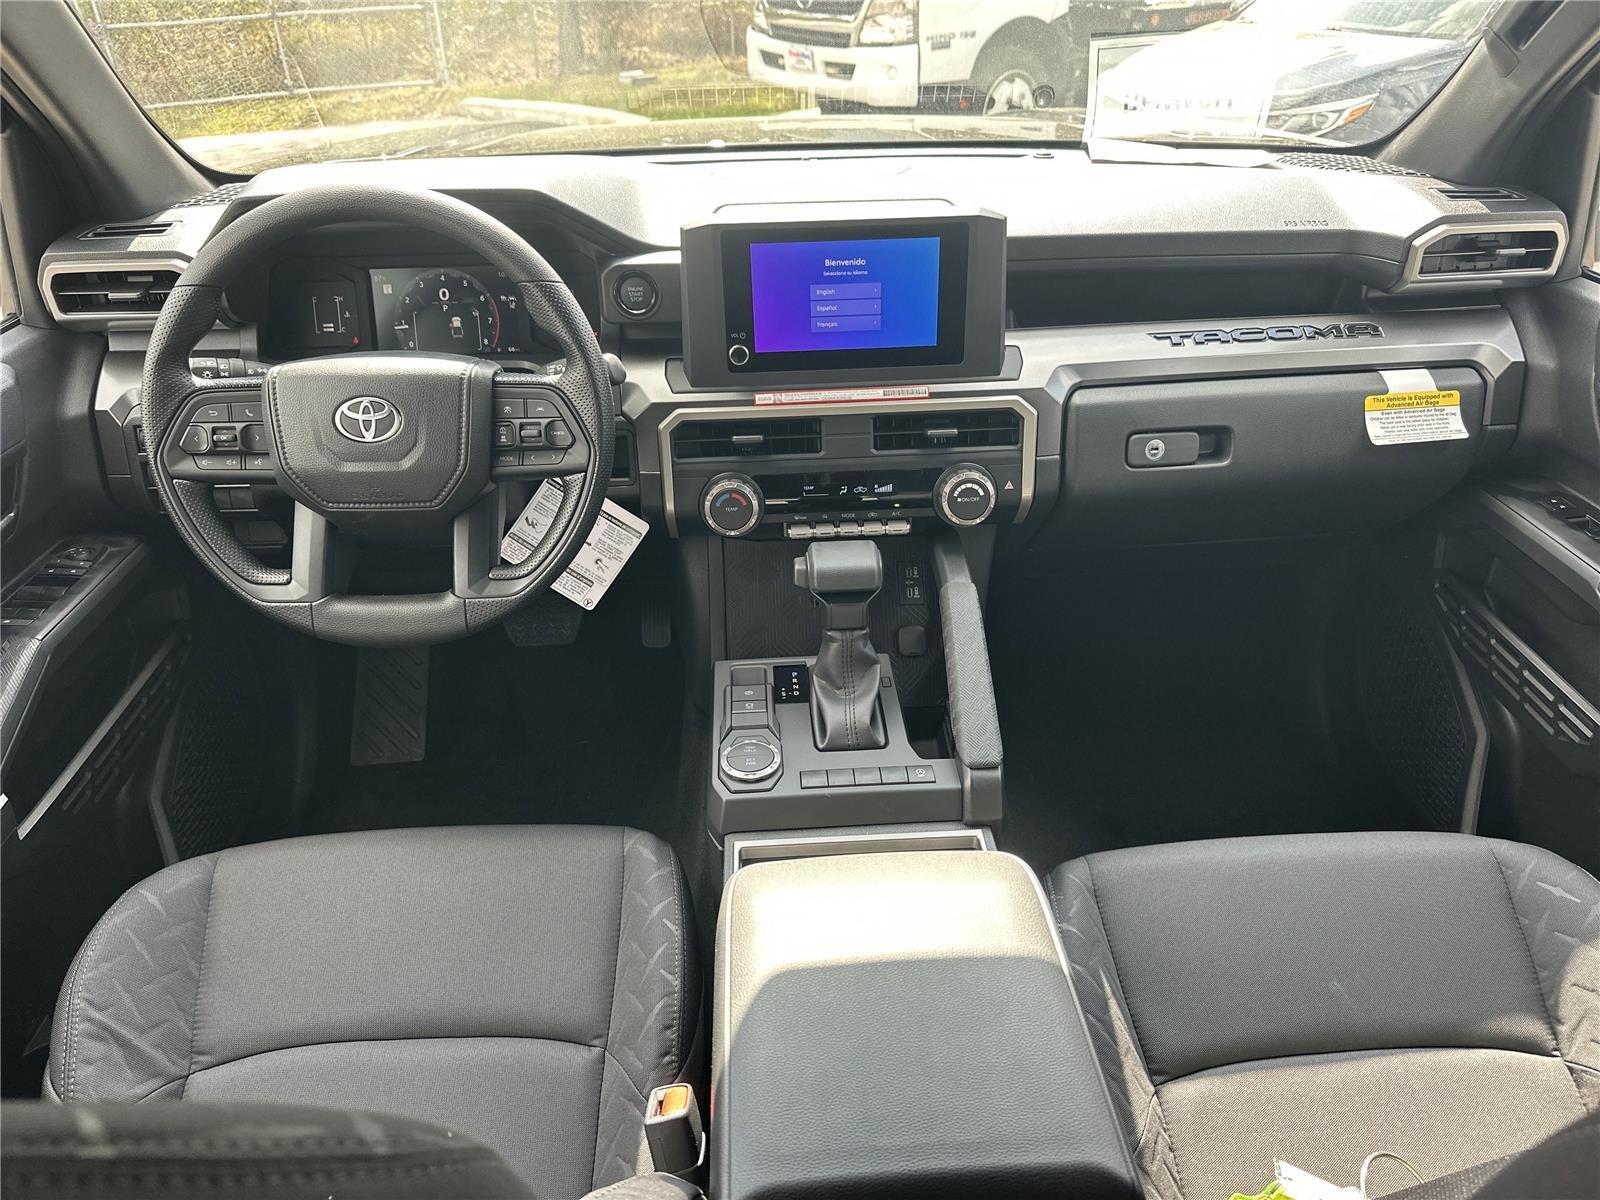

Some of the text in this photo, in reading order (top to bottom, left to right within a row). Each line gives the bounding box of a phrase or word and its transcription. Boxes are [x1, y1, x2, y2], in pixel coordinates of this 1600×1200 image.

[824, 257, 866, 267] Bienvenido
[439, 288, 449, 301] 0
[816, 304, 838, 312] Español
[1148, 322, 1384, 346] TACOMA
[1414, 393, 1441, 401] Equipped
